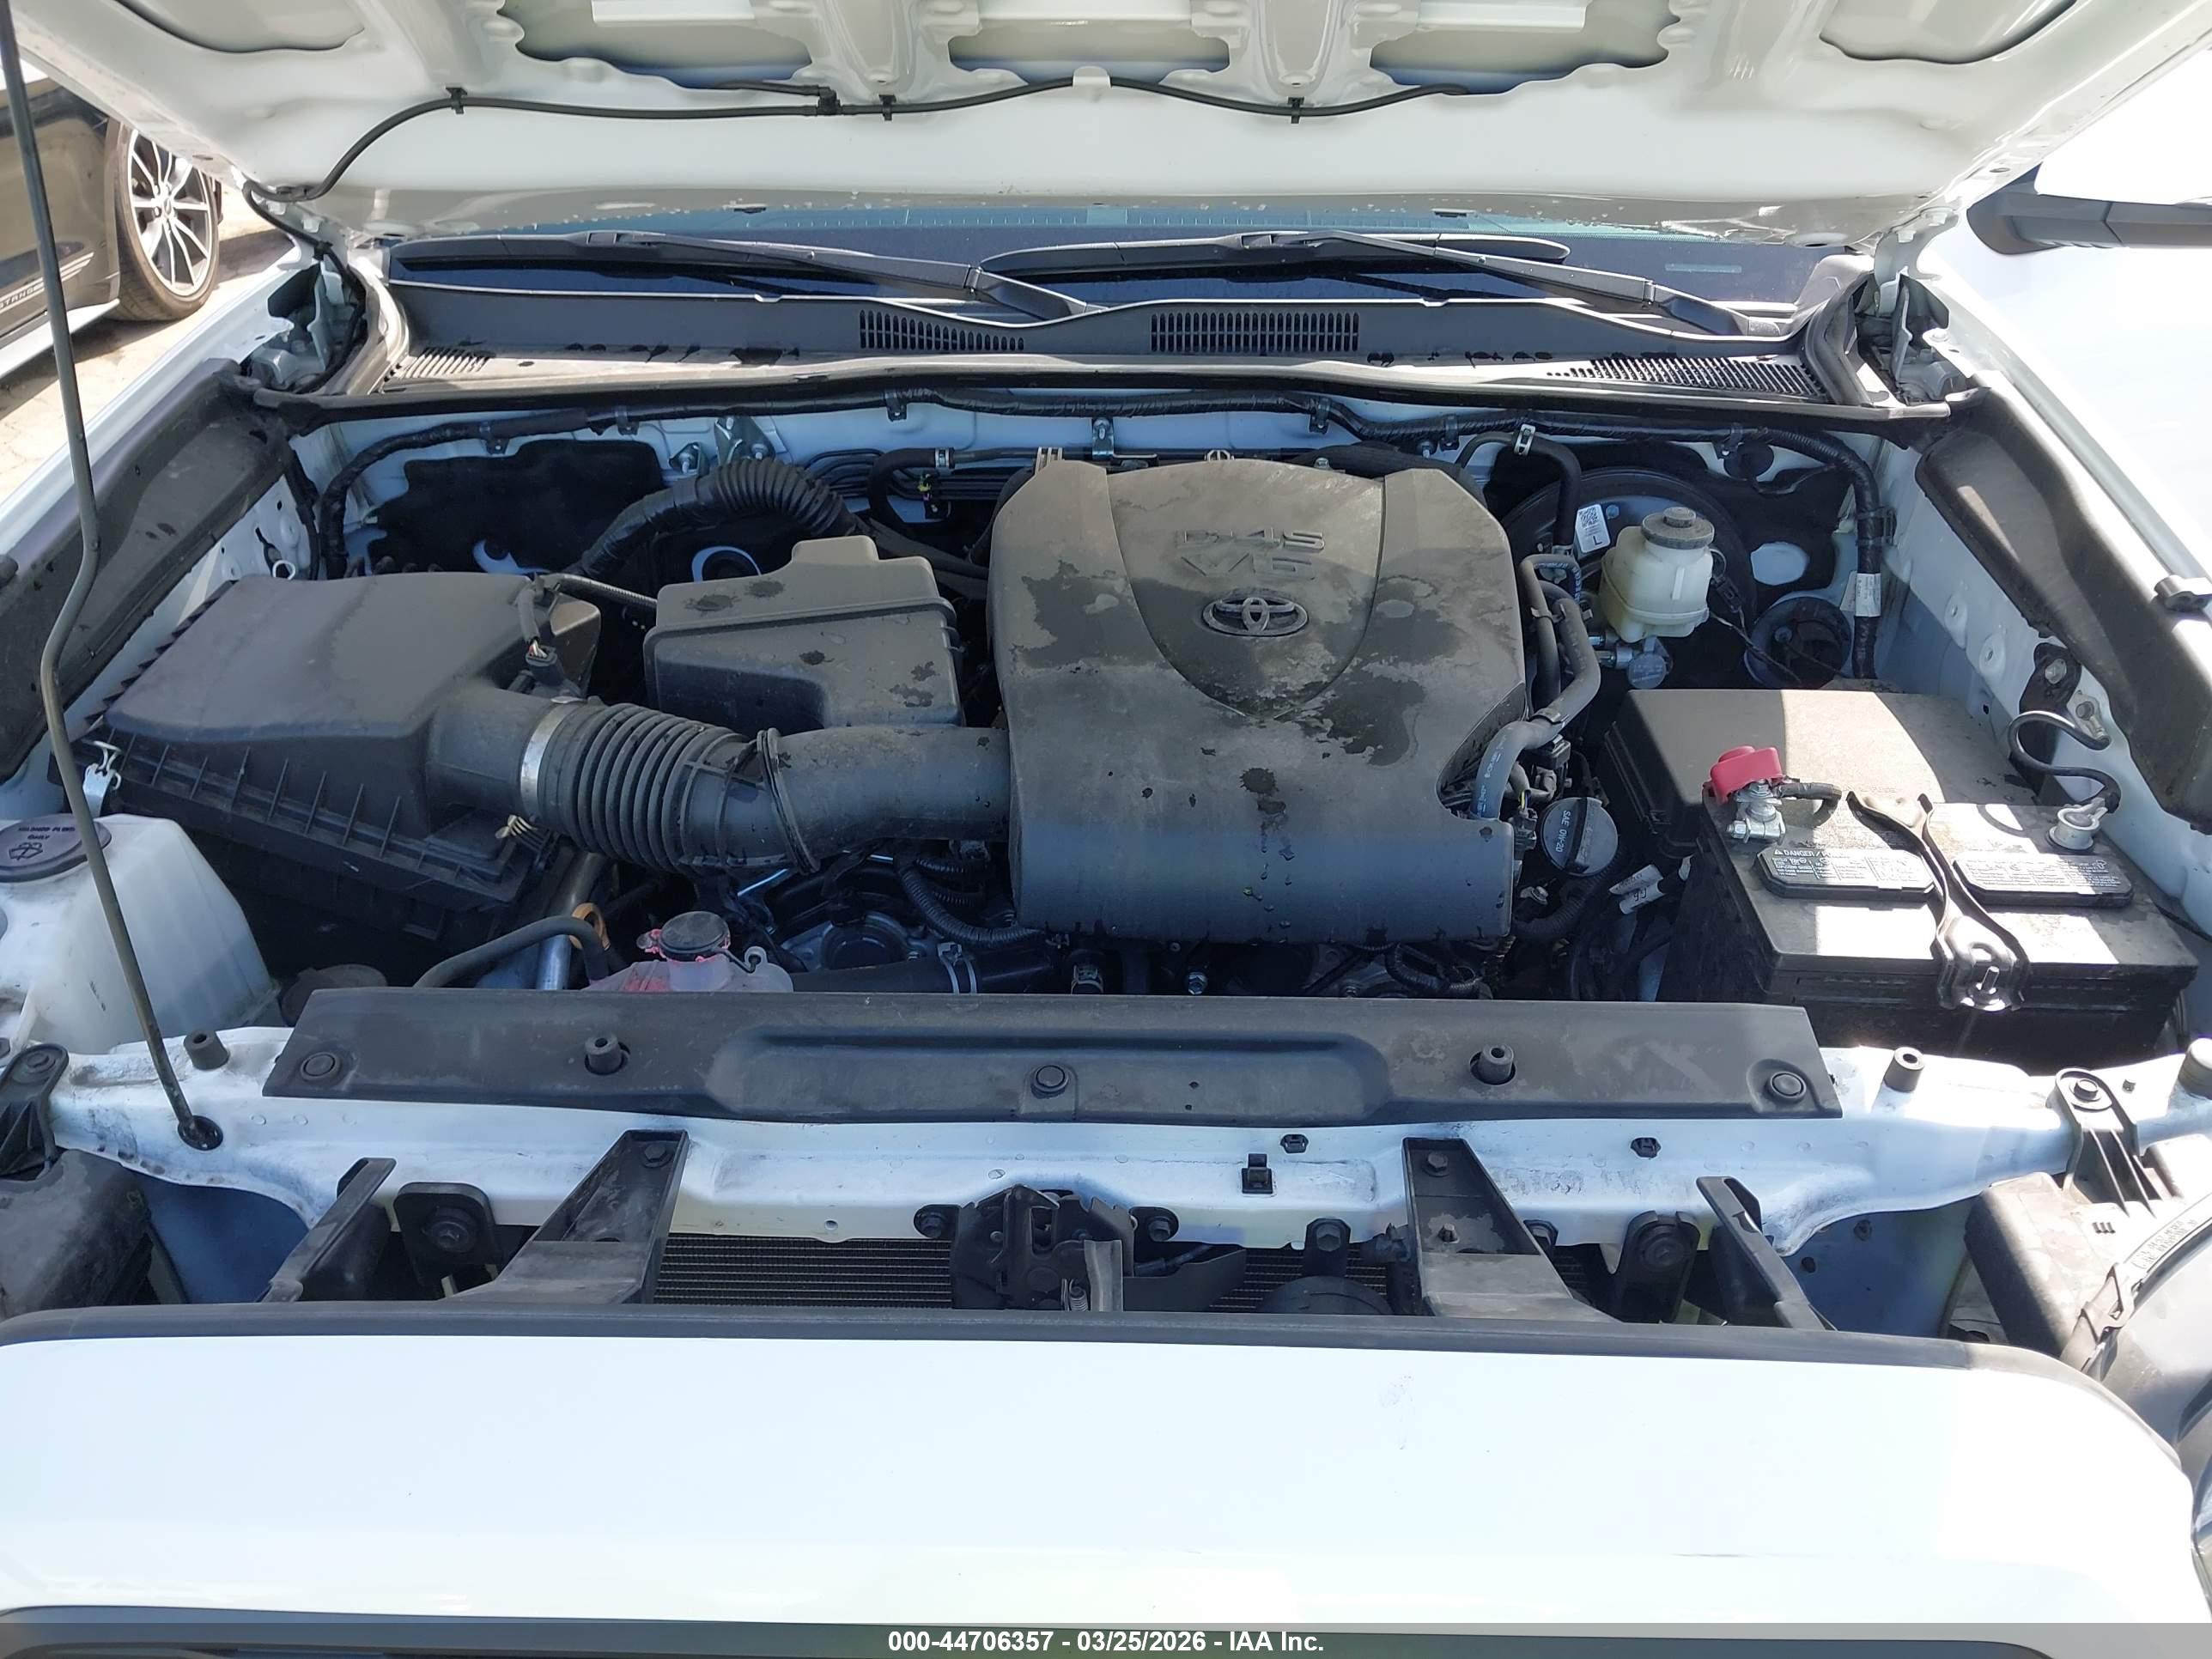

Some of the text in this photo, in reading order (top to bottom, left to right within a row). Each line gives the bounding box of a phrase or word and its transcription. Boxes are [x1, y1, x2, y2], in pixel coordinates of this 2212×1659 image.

[1592, 535, 1603, 546] L
[1555, 810, 1571, 853] SAE 0W-20
